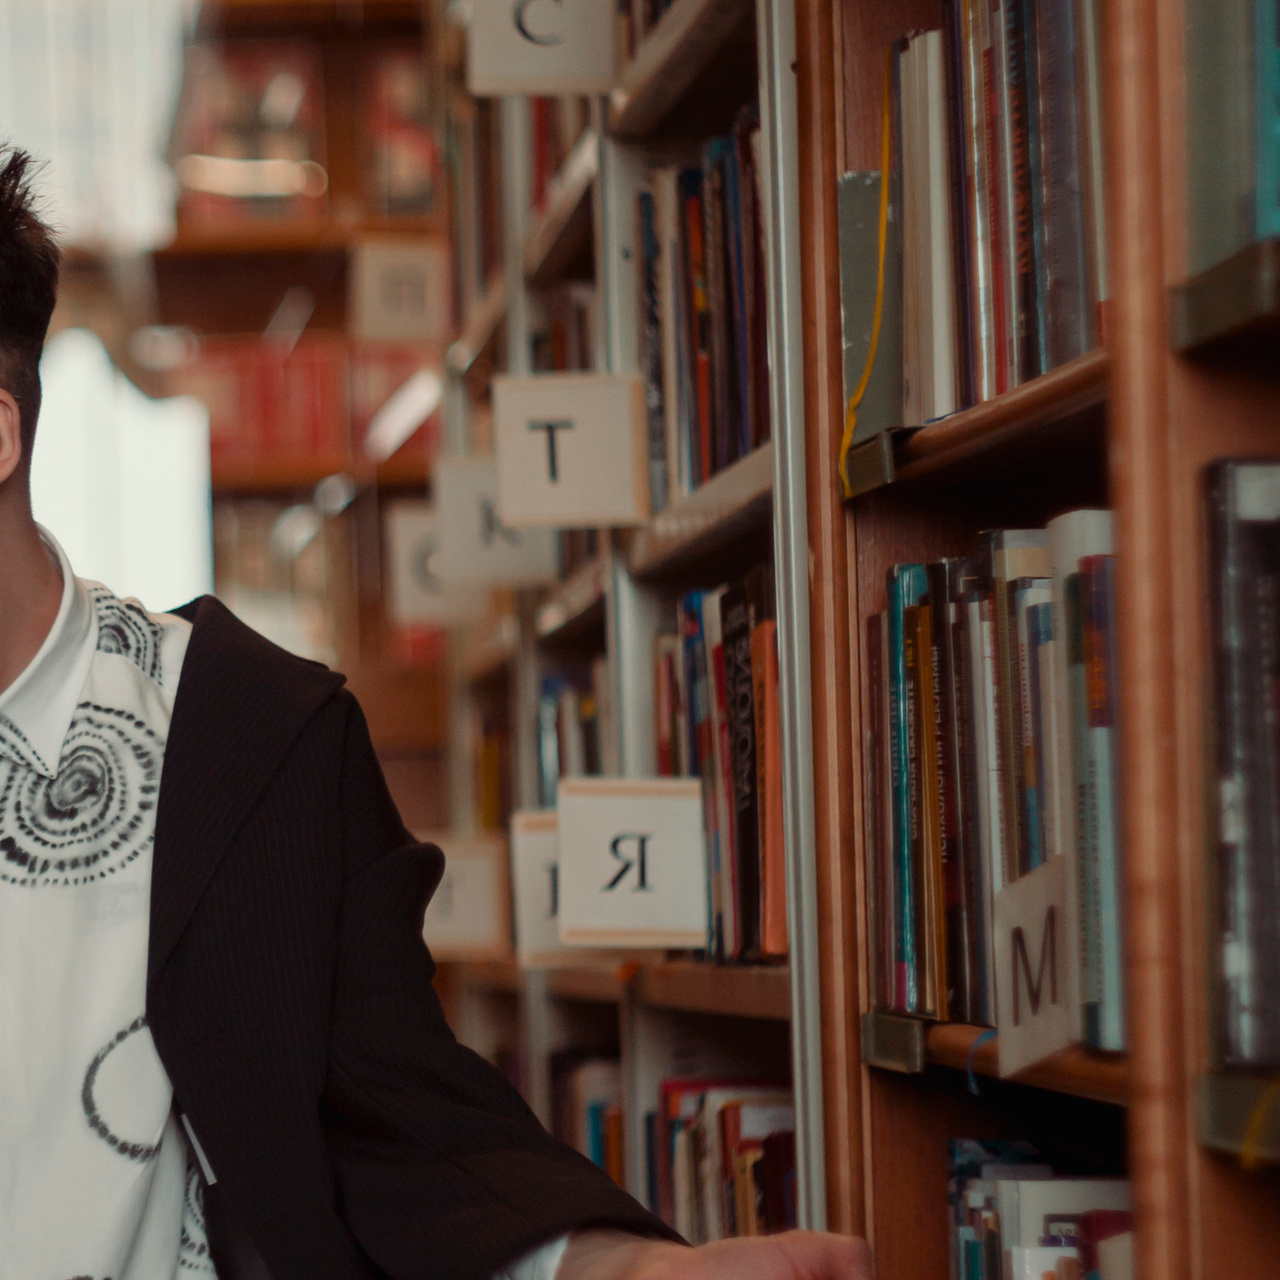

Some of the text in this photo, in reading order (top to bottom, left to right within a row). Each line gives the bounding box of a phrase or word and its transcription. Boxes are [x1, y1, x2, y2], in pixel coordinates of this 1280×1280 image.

[528, 420, 574, 484] Т
[604, 833, 652, 892] Я
[1011, 904, 1061, 1028] М
